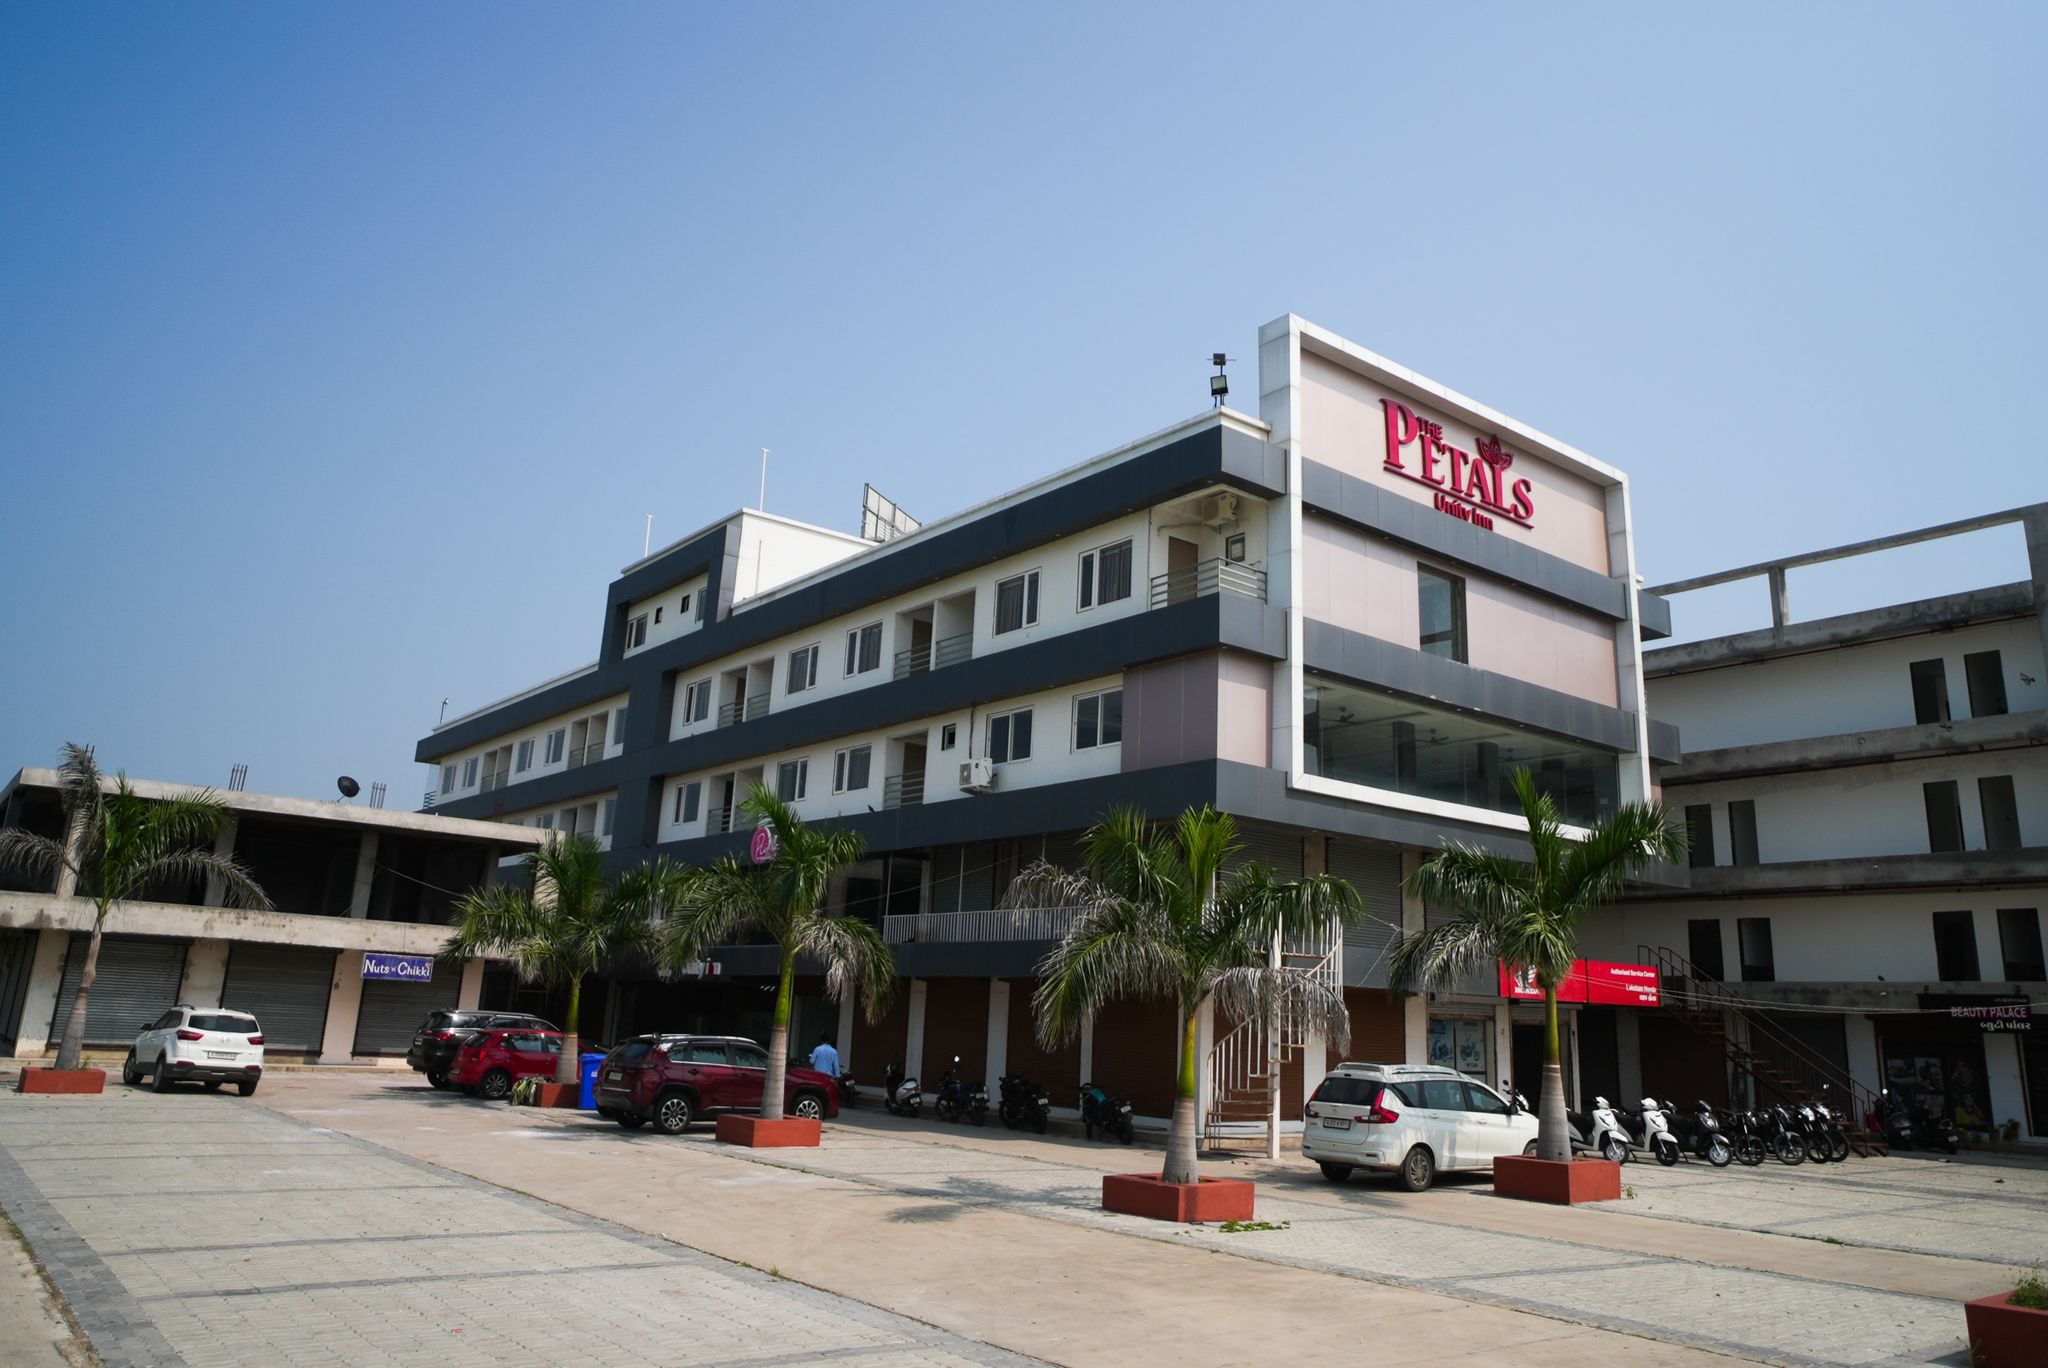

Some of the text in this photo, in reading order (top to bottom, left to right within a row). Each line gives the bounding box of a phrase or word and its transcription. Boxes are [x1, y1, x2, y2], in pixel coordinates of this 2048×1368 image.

[1416, 416, 1443, 441] THE
[1379, 398, 1534, 520] PETALS
[1433, 492, 1493, 531] Unity Inn
[363, 959, 390, 975] Nuts
[397, 961, 430, 977] Chikki
[1950, 1006, 2027, 1018] BEAUTY PALACE
